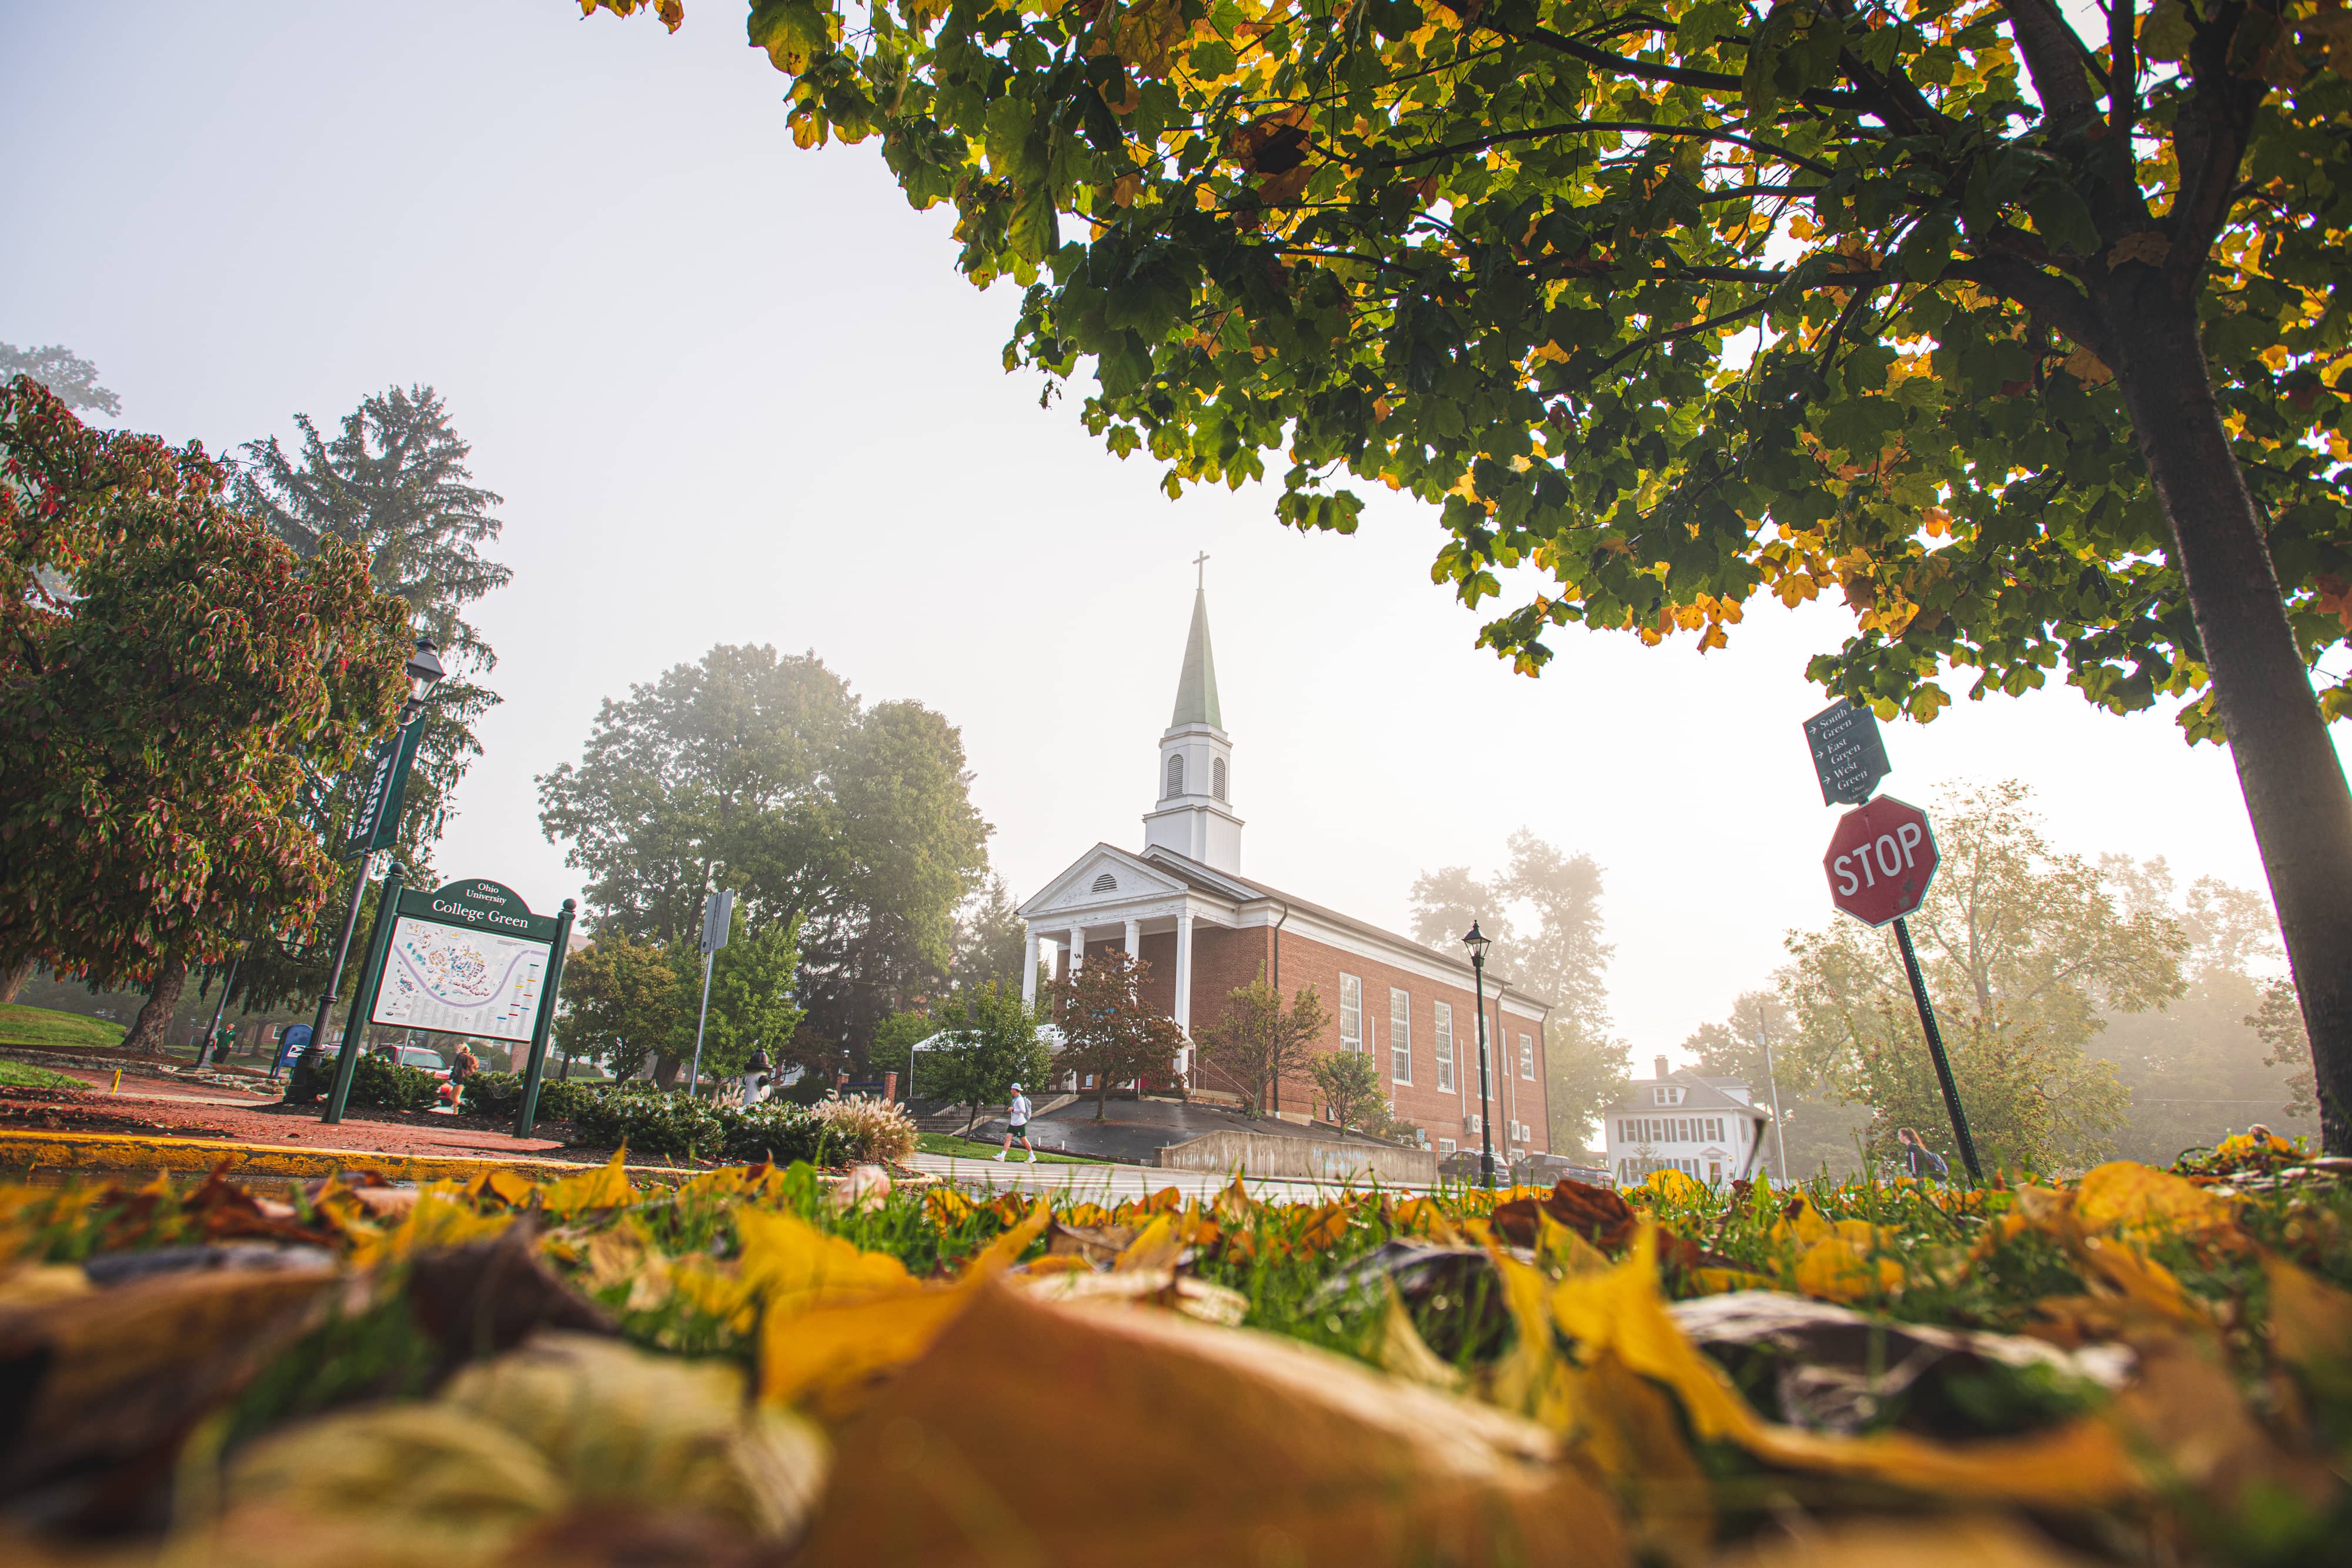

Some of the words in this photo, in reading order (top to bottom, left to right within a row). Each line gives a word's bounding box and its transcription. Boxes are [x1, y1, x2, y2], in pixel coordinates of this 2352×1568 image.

[1820, 708, 1847, 729] South
[1823, 720, 1852, 740] Green
[1827, 738, 1847, 754] East
[1831, 744, 1861, 764] Green
[1833, 762, 1857, 779] West
[1838, 771, 1868, 790] Green
[360, 754, 391, 836] HOME
[1833, 822, 1922, 897] STOP
[466, 889, 507, 906] University
[477, 882, 499, 894] Ohio
[432, 899, 485, 922] College
[488, 910, 529, 928] Green
